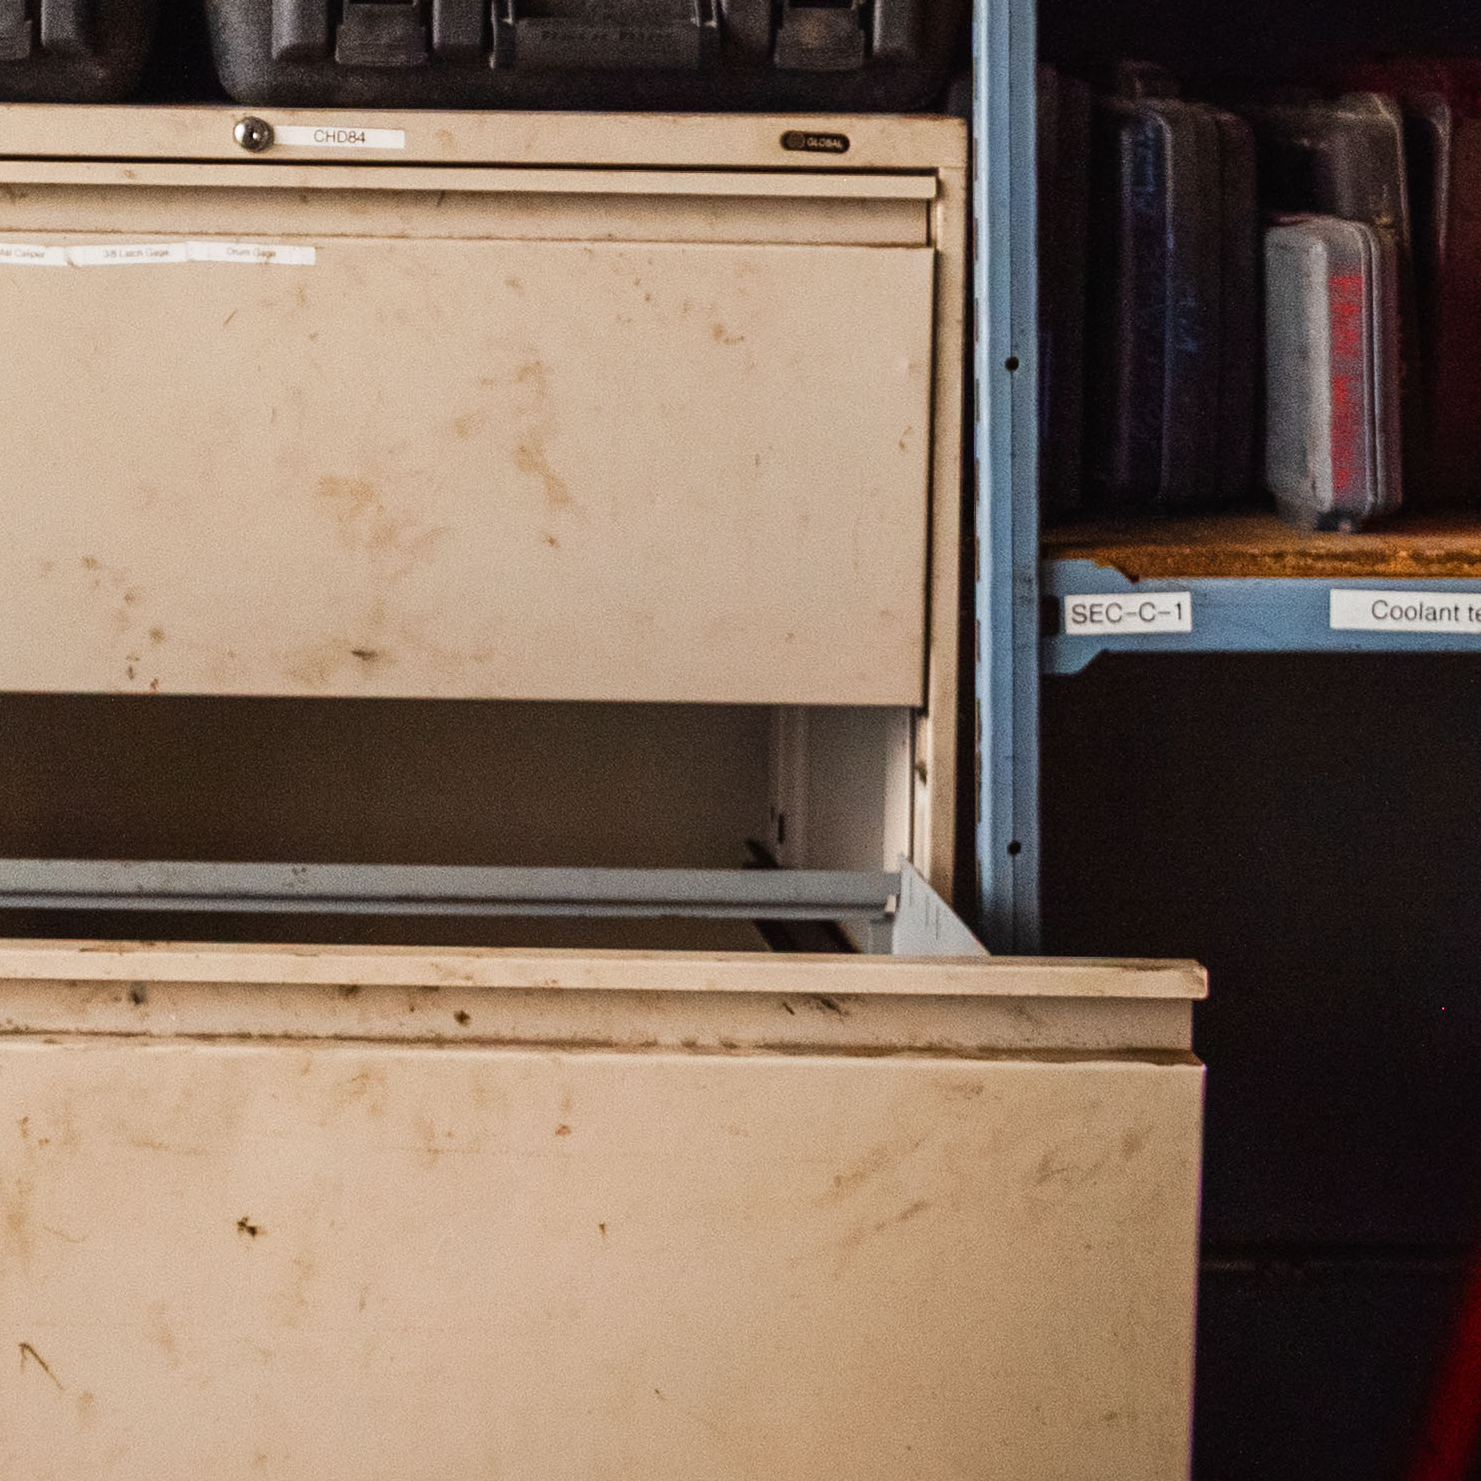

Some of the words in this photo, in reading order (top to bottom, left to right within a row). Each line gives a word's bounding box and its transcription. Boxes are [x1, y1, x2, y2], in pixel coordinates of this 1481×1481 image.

[313, 129, 366, 145] CHD84
[1071, 602, 1185, 625] SEC-C-1
[1371, 600, 1460, 624] Coolant
